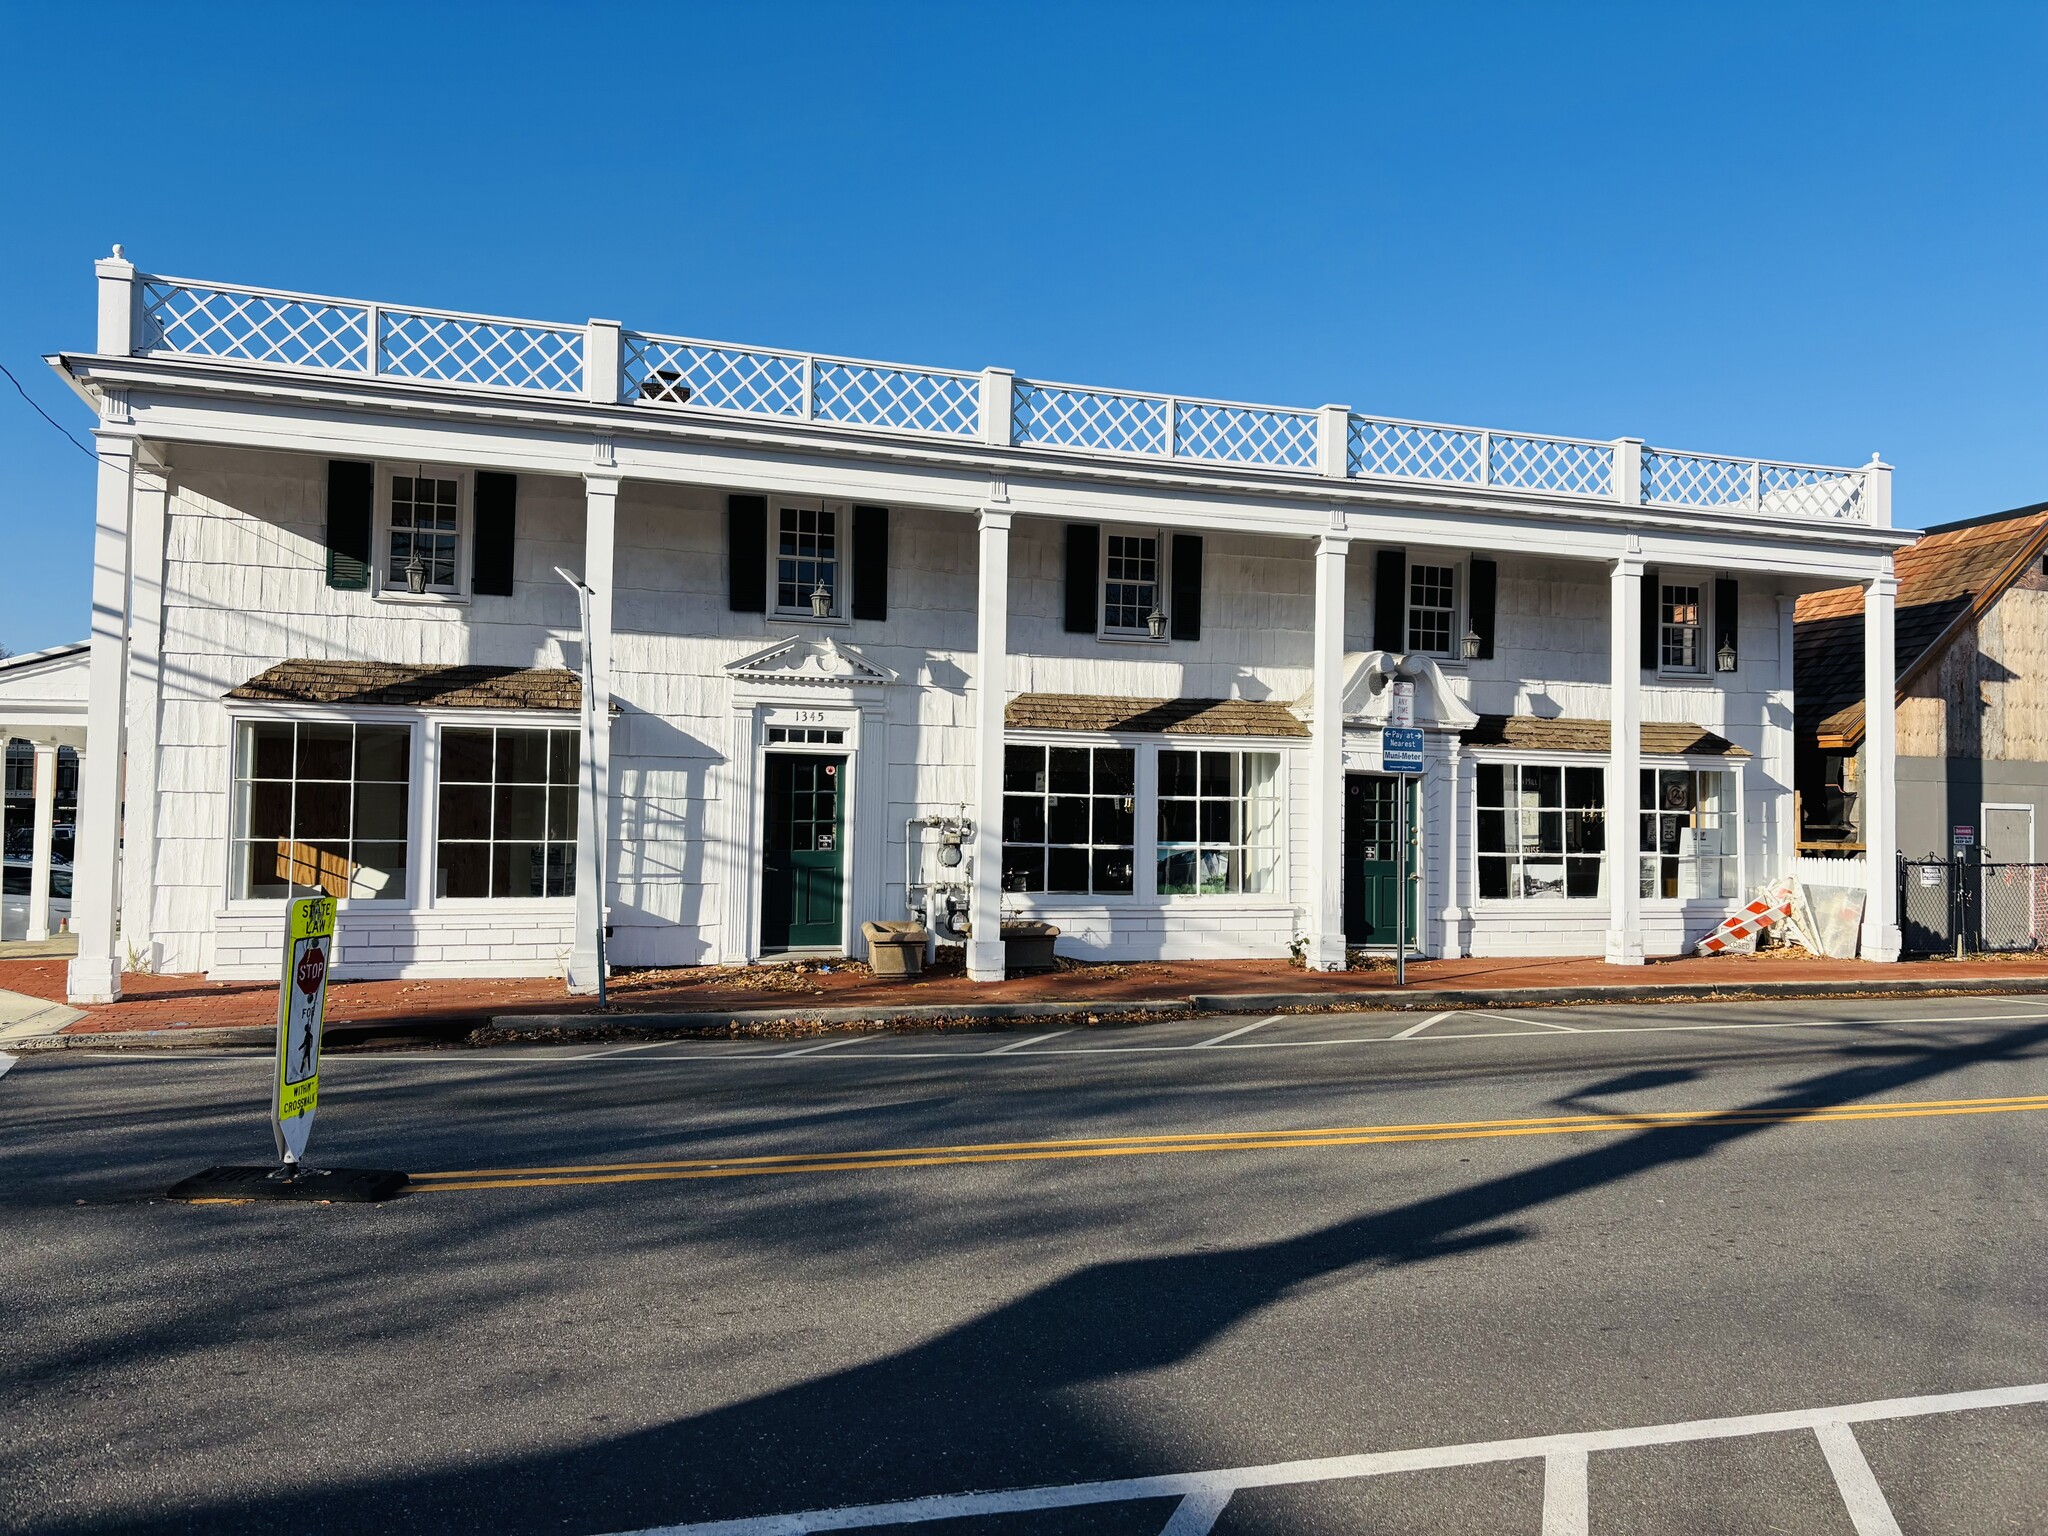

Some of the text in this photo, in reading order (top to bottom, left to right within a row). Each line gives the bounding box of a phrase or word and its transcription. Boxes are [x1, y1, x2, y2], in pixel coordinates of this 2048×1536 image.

[1397, 706, 1409, 714] TIME
[795, 711, 824, 722] 1345
[1391, 730, 1402, 739] Pay
[1390, 740, 1416, 748] Nearest
[1384, 751, 1421, 760] Muni-Meter
[302, 903, 331, 918] STATE
[306, 920, 326, 934] LAW
[1727, 941, 1750, 950] LOSED
[299, 962, 324, 981] STOP
[302, 1006, 315, 1019] FOR
[294, 1083, 312, 1097] WITHIN
[284, 1093, 315, 1113] CROSSWALK
